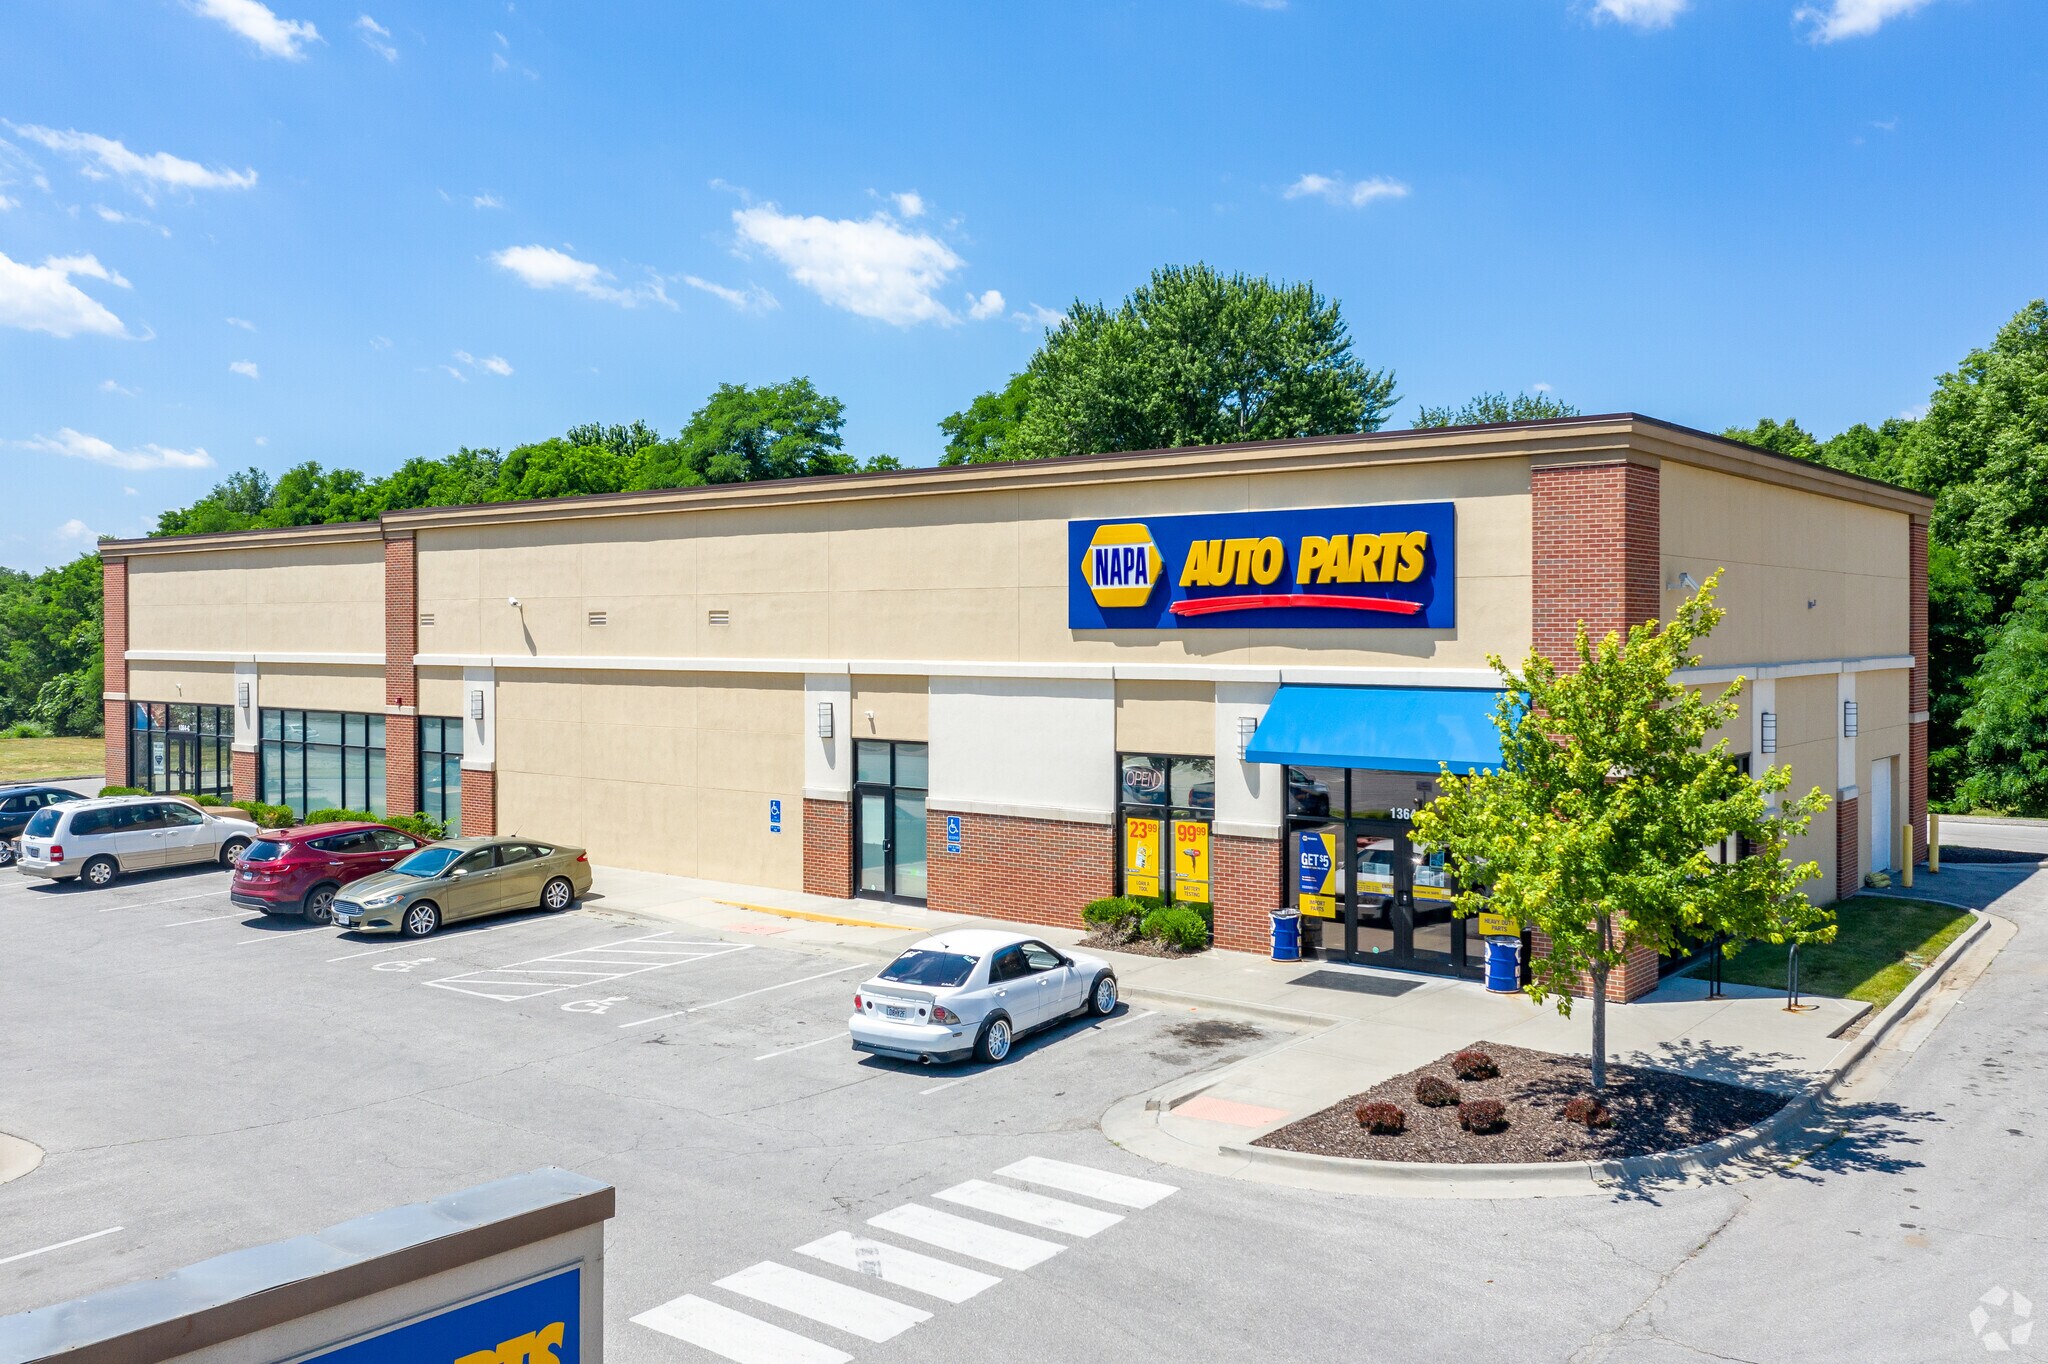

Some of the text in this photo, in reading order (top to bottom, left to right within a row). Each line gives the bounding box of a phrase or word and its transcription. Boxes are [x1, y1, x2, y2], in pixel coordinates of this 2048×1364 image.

[1095, 531, 1429, 587] NAPA AUTO PARTS
[1126, 770, 1156, 787] OPEN
[1301, 852, 1329, 867] GET $5
[1484, 917, 1500, 925] HEAVY
